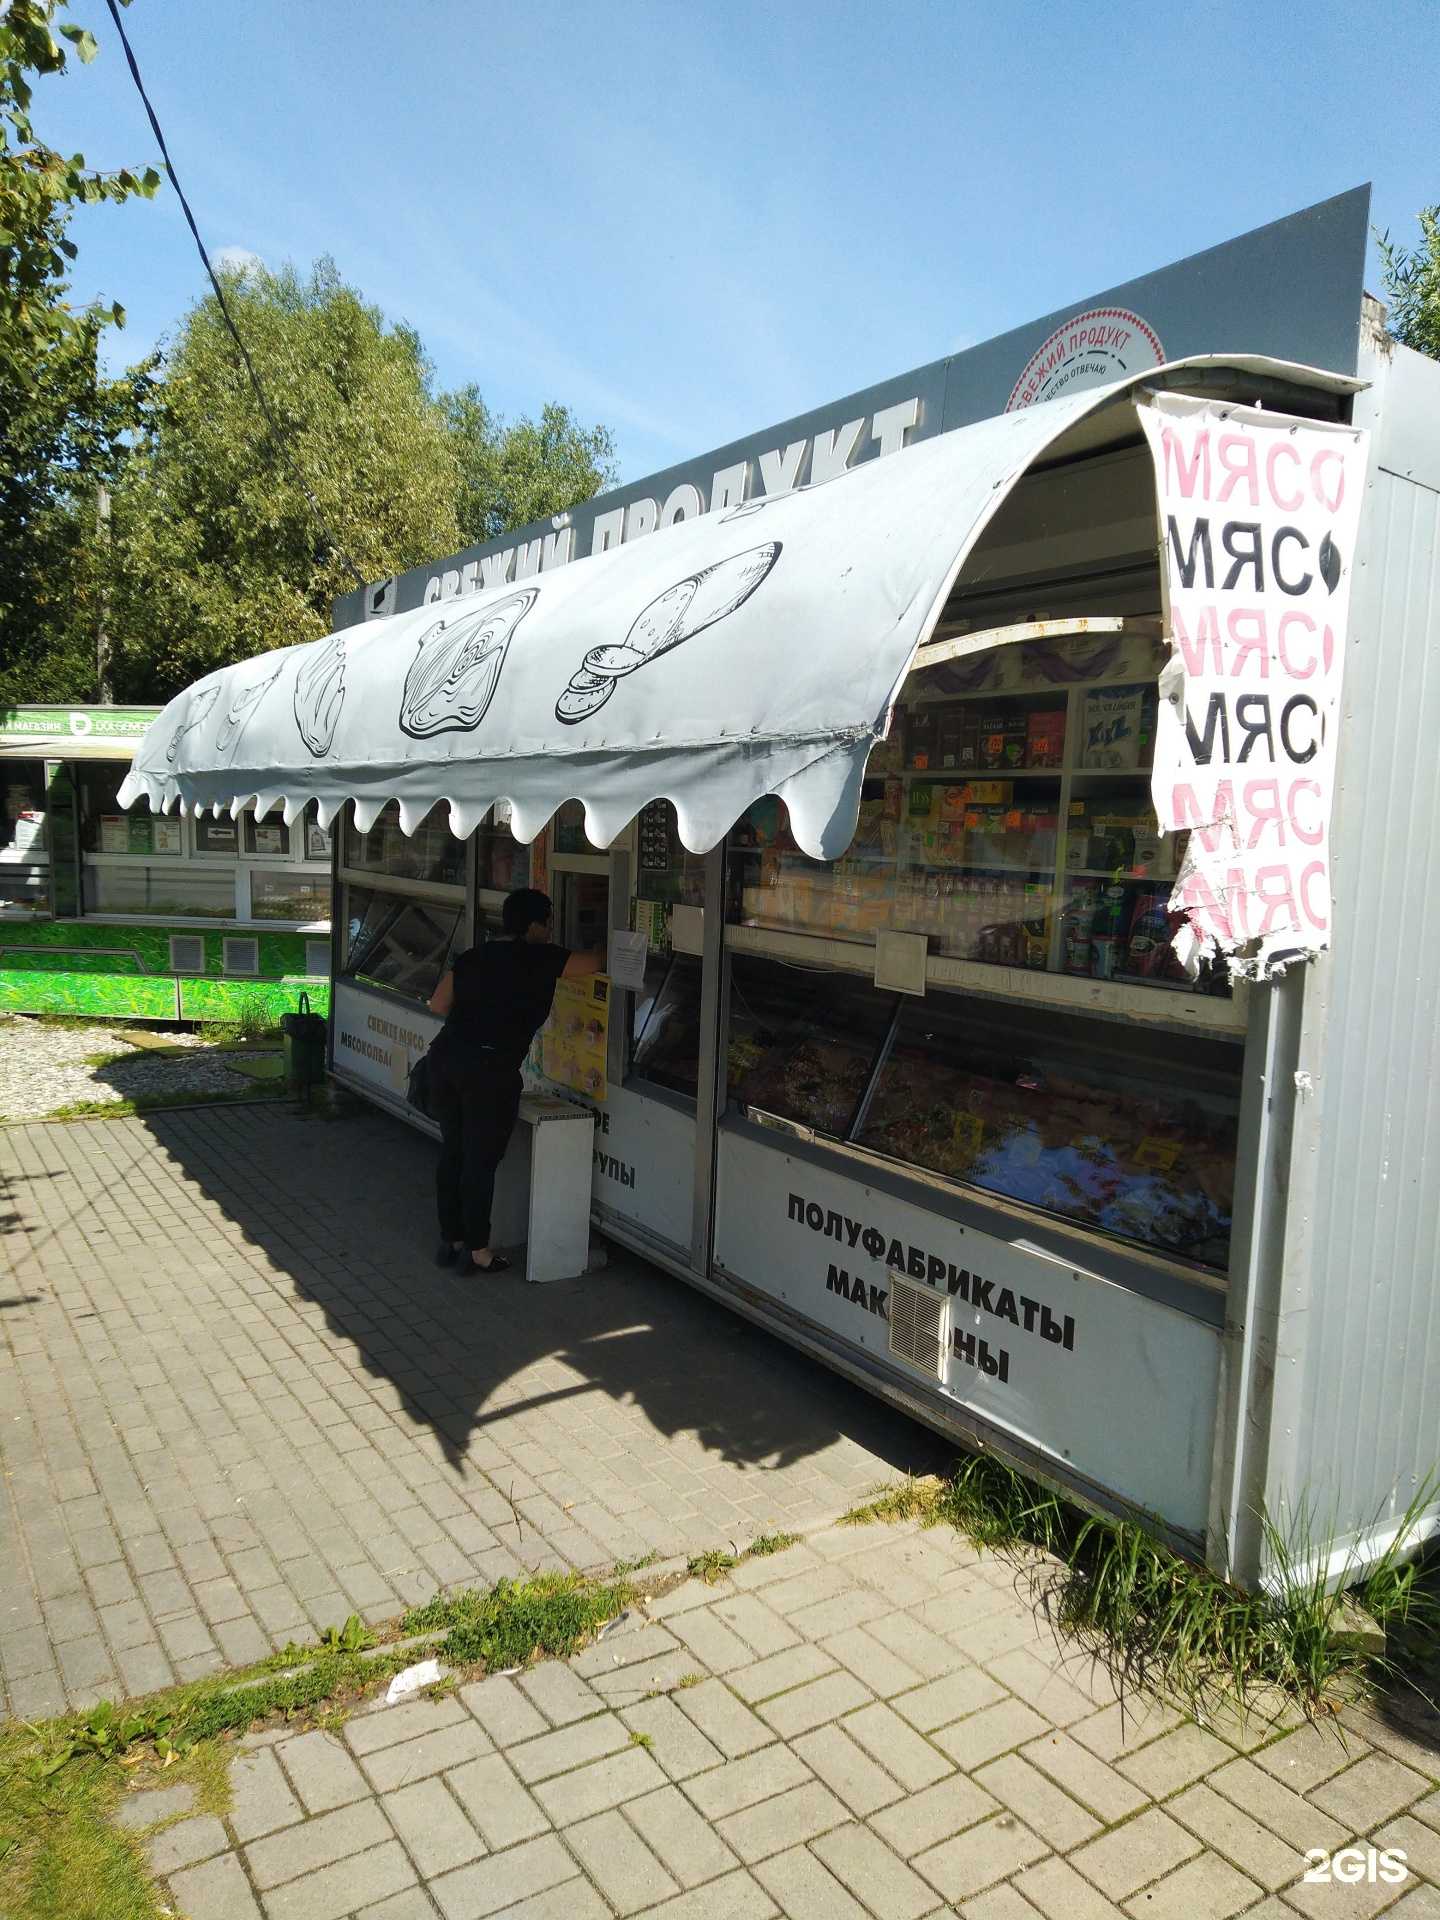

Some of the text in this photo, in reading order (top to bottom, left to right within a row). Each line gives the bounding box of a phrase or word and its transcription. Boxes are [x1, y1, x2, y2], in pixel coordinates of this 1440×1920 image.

[1070, 326, 1132, 352] ПРОДУКТ
[1045, 362, 1106, 401] ЕСТВО ОТВЕЧАЮ
[424, 397, 919, 607] СВЕЖИЙ ПРОДУКТ
[1161, 426, 1345, 513] МЯСО
[1172, 606, 1334, 680] МЯС
[1185, 692, 1325, 764] МЯС
[1172, 778, 1324, 853] МЯС
[399, 1029, 424, 1050] МЯСО
[787, 1193, 1076, 1351] ПОЛУФАБРИКАТЫ
